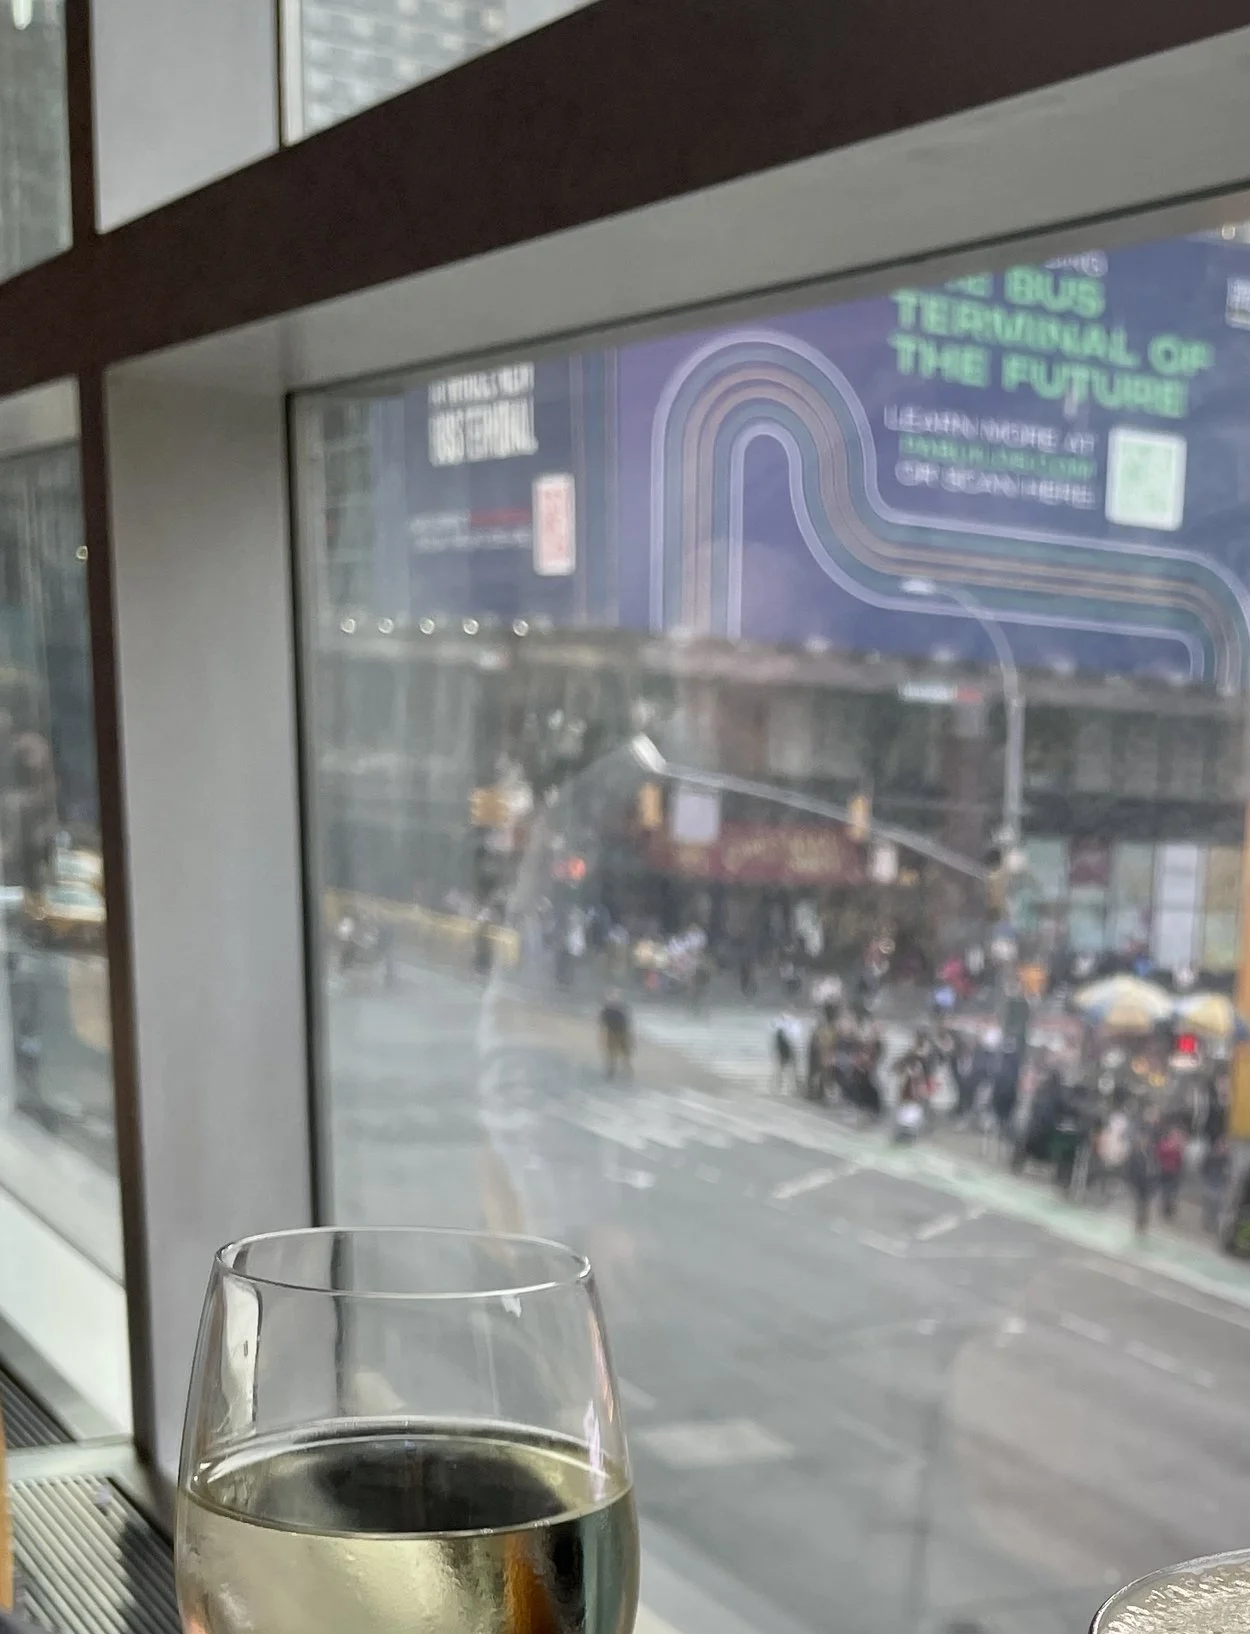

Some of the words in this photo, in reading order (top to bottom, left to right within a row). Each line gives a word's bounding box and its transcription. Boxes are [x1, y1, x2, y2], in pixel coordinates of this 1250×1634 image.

[893, 287, 1141, 369] TERMINAL
[1148, 335, 1216, 376] OF
[1004, 266, 1106, 318] BUS
[890, 331, 991, 388] THE
[1001, 353, 1188, 418] FUTURE
